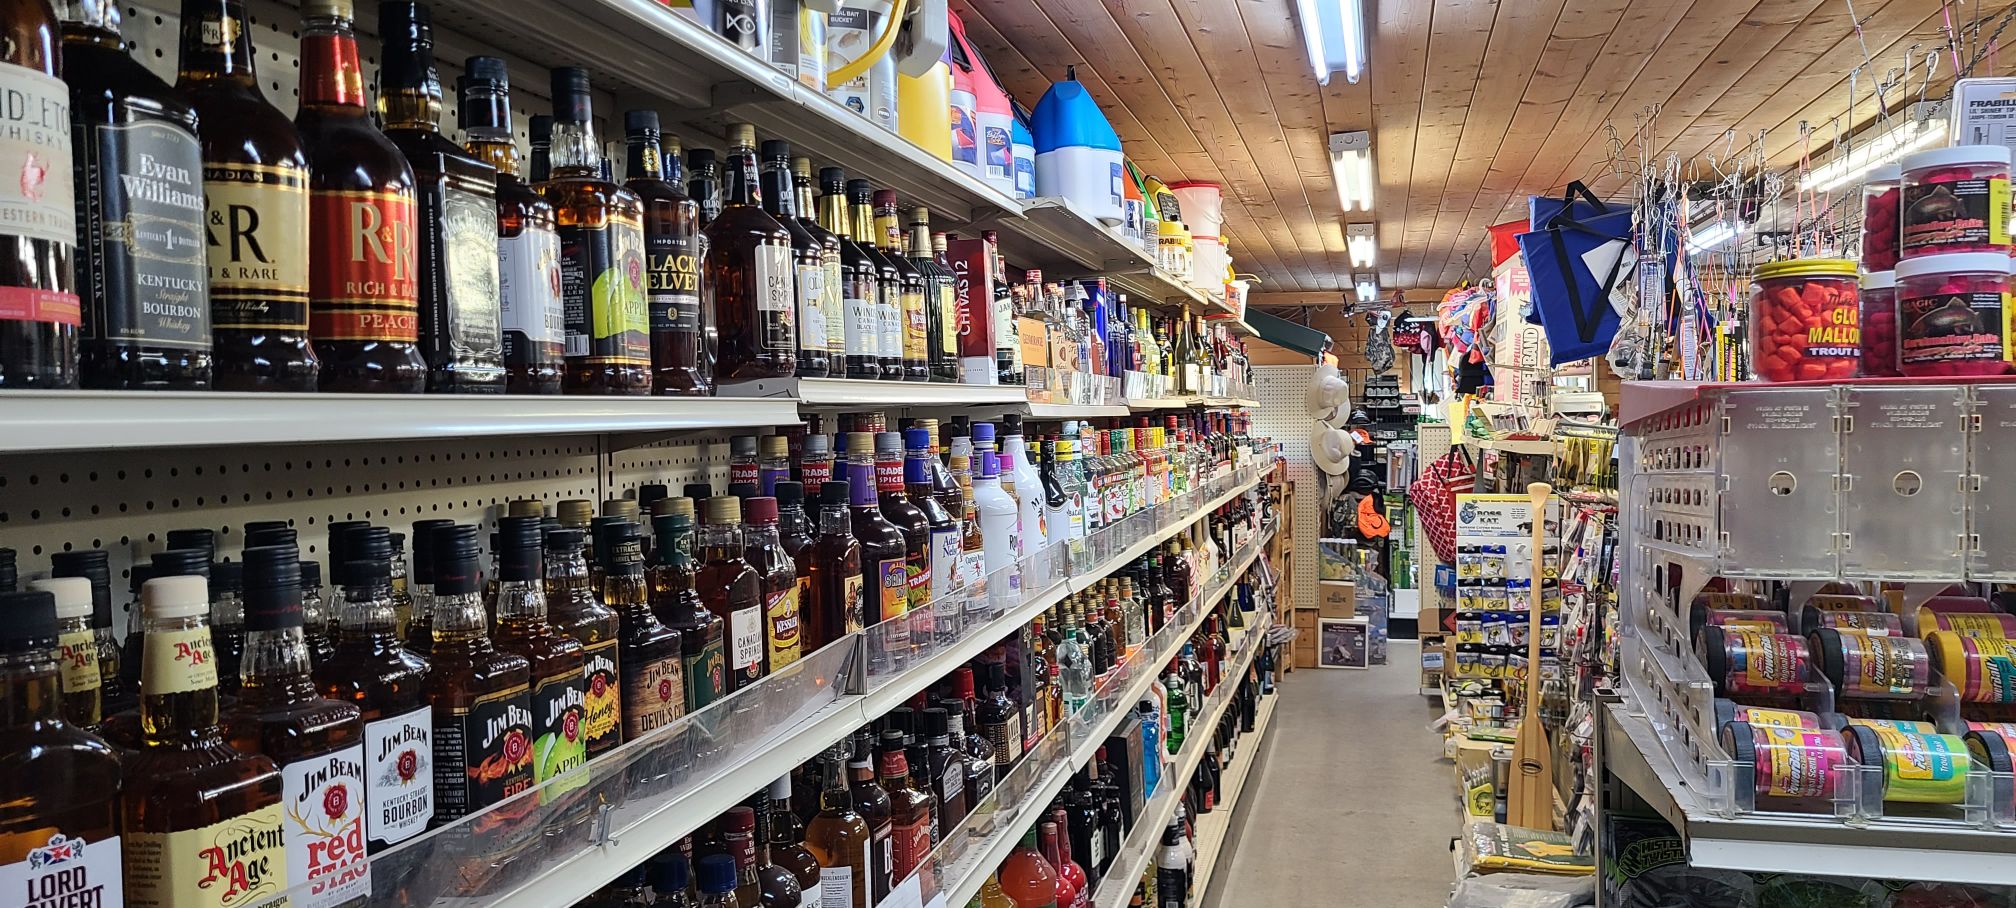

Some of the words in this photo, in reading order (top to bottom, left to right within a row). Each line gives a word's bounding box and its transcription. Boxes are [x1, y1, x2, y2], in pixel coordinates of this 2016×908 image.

[830, 16, 853, 24] BUCKET
[849, 10, 860, 18] BAIT
[0, 88, 69, 136] DLETO
[139, 153, 191, 185] Evan
[204, 169, 263, 182] ADIAN
[89, 164, 98, 206] EXTRA
[120, 174, 205, 211] Williams
[0, 208, 45, 224] ESTERN
[91, 212, 100, 246] AGED
[352, 202, 415, 281] R&R
[93, 253, 101, 266] IN
[648, 254, 697, 273] LACK
[955, 260, 968, 277] 12
[94, 272, 102, 299] OAK
[137, 274, 203, 292] KENTUCKY
[239, 267, 279, 281] RARE
[647, 272, 698, 290] ELVET
[155, 289, 189, 303] Straight
[347, 281, 384, 296] RICH
[143, 302, 201, 319] BOURBON
[853, 306, 876, 318] WIND
[878, 310, 900, 321] WIND
[958, 278, 971, 336] CHIVAS
[1832, 308, 1857, 324] GLO
[158, 317, 191, 332] Whiskey
[360, 313, 417, 329] PEACH
[1513, 333, 1521, 374] REPELLING
[1809, 347, 1852, 356] TROUT
[1512, 375, 1521, 400] INSECT
[615, 545, 640, 553] XTRACTE
[776, 617, 798, 632] KESSLER
[738, 633, 762, 648] CANADIAN
[1779, 641, 1788, 657] Scent
[584, 662, 595, 679] IM
[595, 654, 615, 670] BEAM
[647, 666, 661, 689] JIM
[661, 661, 680, 675] BEAM
[1988, 658, 2003, 702] owerBait
[545, 697, 566, 727] JIM
[584, 699, 614, 727] Honey
[641, 704, 674, 732] DEVIL'S
[378, 731, 401, 762] JIM
[403, 723, 427, 746] BEAM
[483, 713, 506, 749] JIM
[1904, 733, 1926, 770] Power
[553, 750, 587, 777] APPLE
[1807, 756, 1817, 778] Scent
[299, 767, 328, 802] JIM
[330, 758, 363, 782] BEAM
[504, 779, 529, 798] FIRE
[383, 792, 408, 808] KENTUCKY
[409, 786, 427, 799] STRAIGHT
[383, 795, 428, 825] BOURBON
[399, 815, 419, 829] WHISKEY
[306, 816, 364, 869] red
[198, 824, 285, 888] Ancient
[28, 866, 87, 903] LORD
[222, 855, 269, 903] Age
[308, 852, 367, 895] STAG
[24, 885, 104, 908] LVERT
